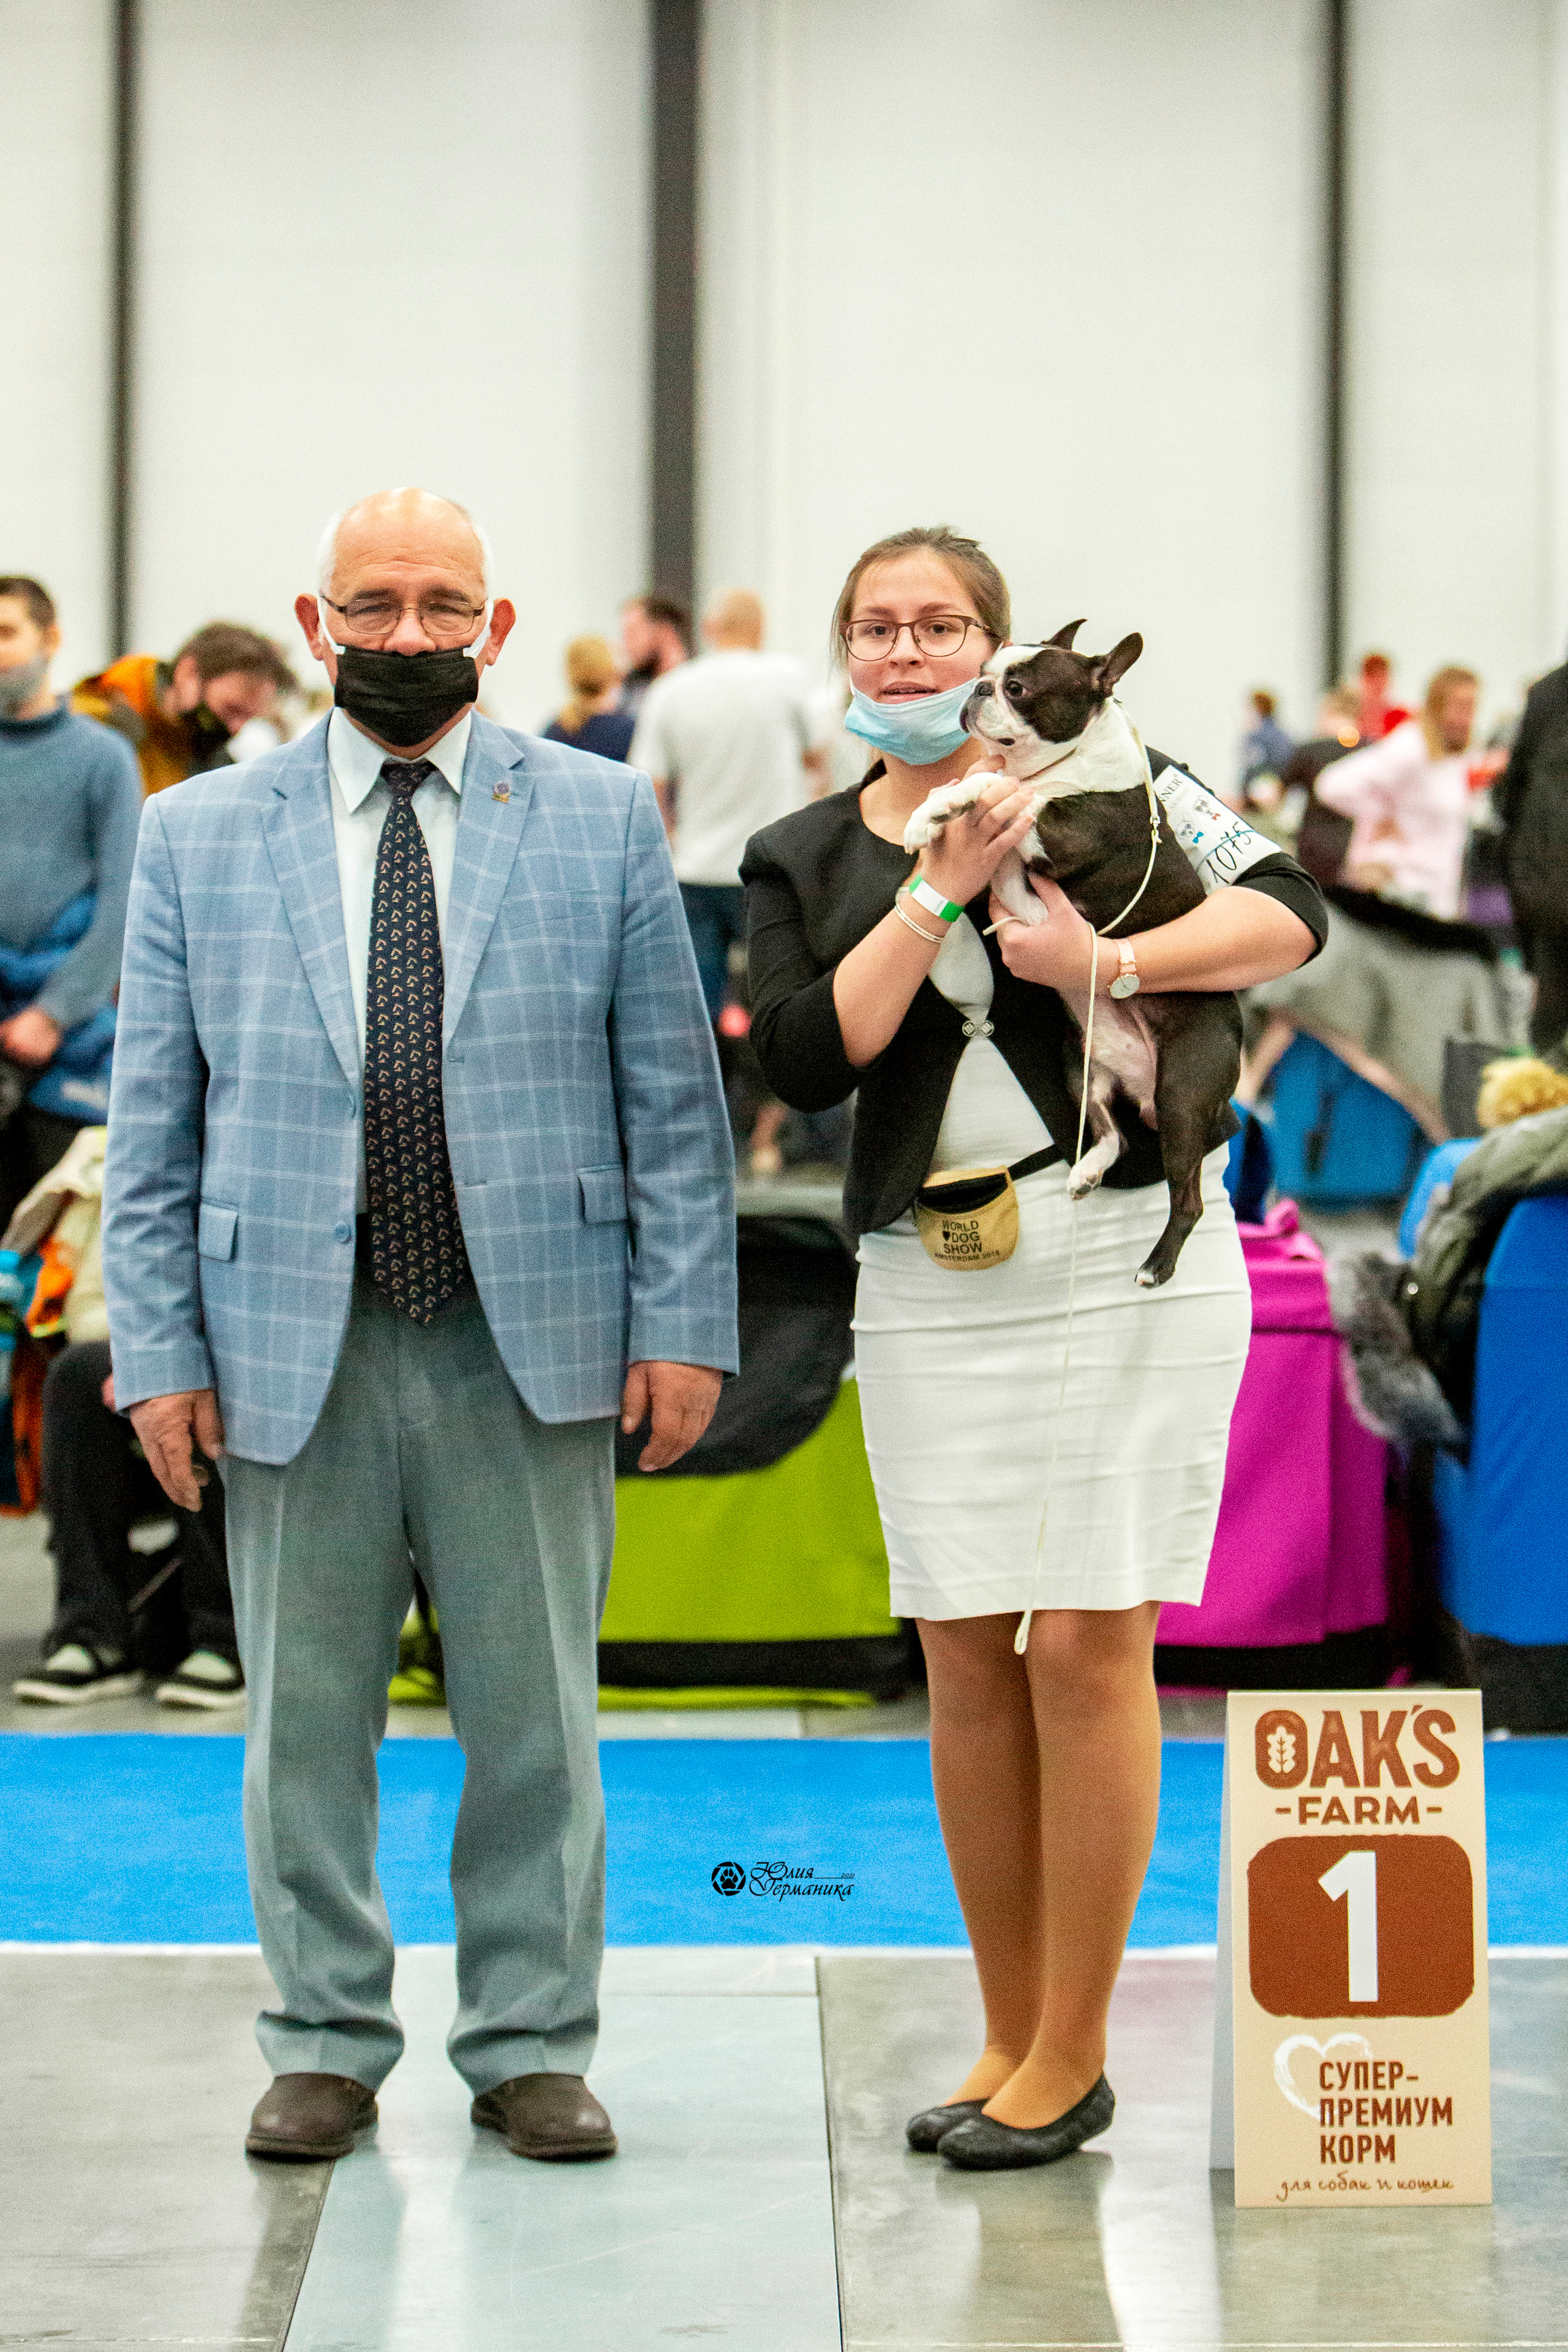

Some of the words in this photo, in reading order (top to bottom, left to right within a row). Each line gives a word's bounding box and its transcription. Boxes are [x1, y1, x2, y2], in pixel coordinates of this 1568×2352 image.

[942, 1220, 979, 1231] WORLD
[952, 1231, 980, 1243] DOG
[943, 1242, 982, 1254] SHOW
[1318, 1851, 1378, 2002] 1
[1319, 2060, 1419, 2090] СУПЕР-
[1320, 2097, 1453, 2127] ПРЕМИУМ
[1320, 2134, 1396, 2164] КОРМ
[1276, 2180, 1311, 2202] для
[1319, 2169, 1371, 2192] собак
[1377, 2179, 1393, 2191] и
[1397, 2178, 1455, 2193] кошек
